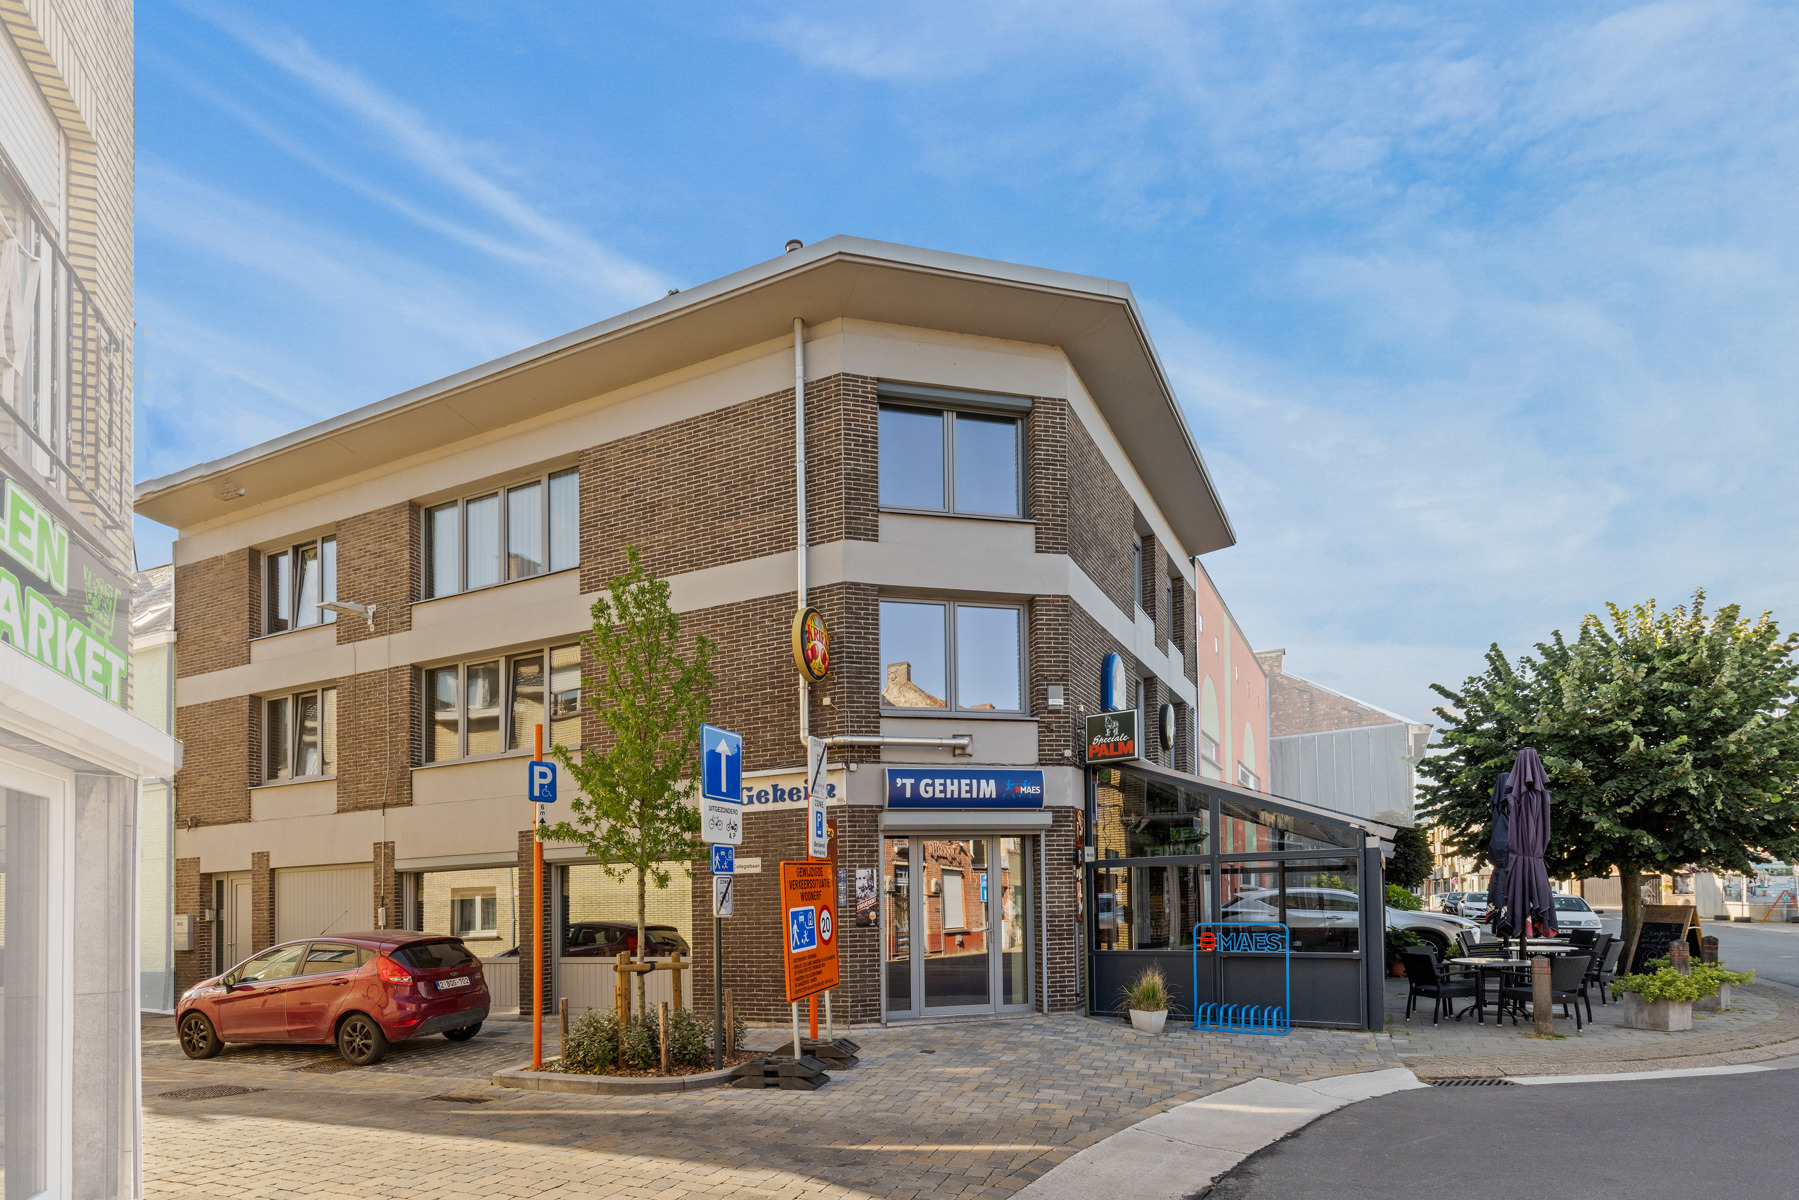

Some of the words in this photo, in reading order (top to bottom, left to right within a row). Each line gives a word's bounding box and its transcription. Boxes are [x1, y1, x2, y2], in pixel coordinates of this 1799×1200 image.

[1093, 733, 1129, 745] Speciale
[1089, 740, 1133, 758] PALM
[534, 766, 552, 796] P
[919, 779, 996, 798] GEHEIM
[1020, 786, 1040, 794] MAES
[821, 916, 831, 933] 20
[1217, 933, 1282, 952] MAES
